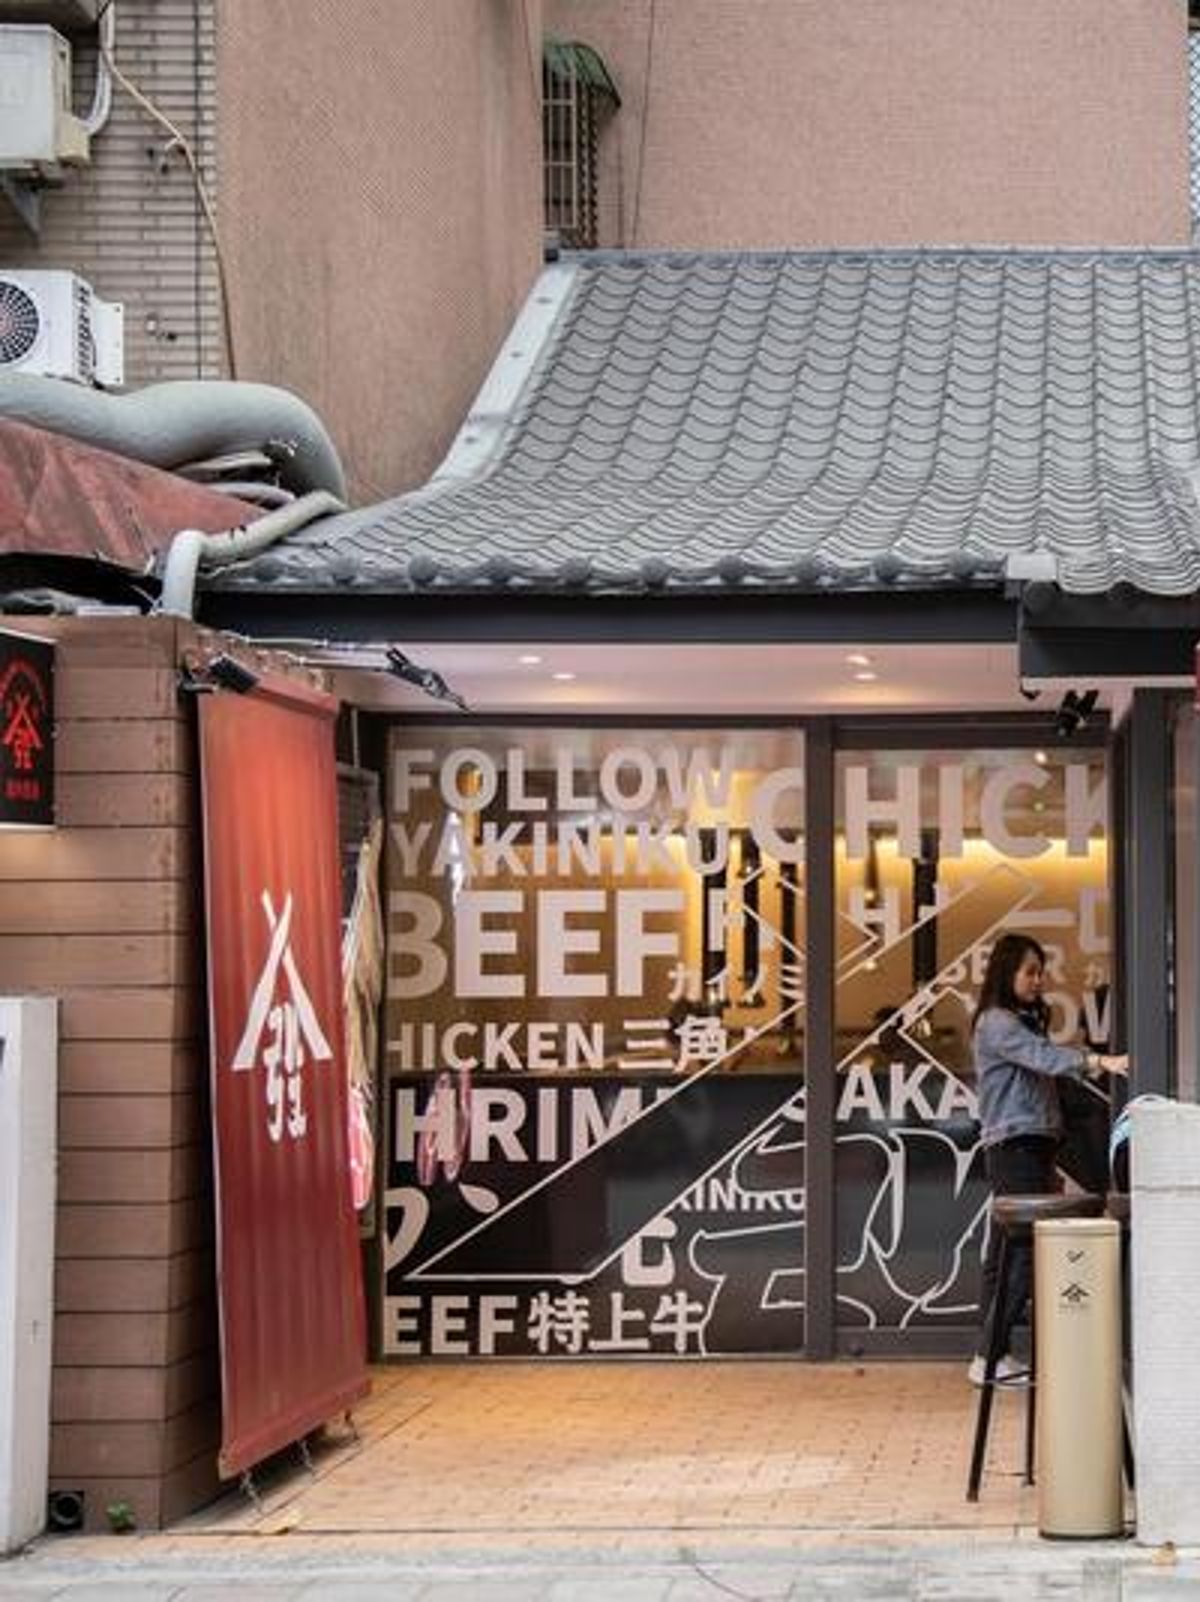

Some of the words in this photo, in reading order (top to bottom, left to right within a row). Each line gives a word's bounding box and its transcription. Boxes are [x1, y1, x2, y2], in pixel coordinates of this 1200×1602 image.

[394, 746, 730, 813] FOLLOW
[390, 821, 730, 877] YAKINIKU
[387, 888, 684, 998] BEEF
[526, 1291, 705, 1355] 特上牛
